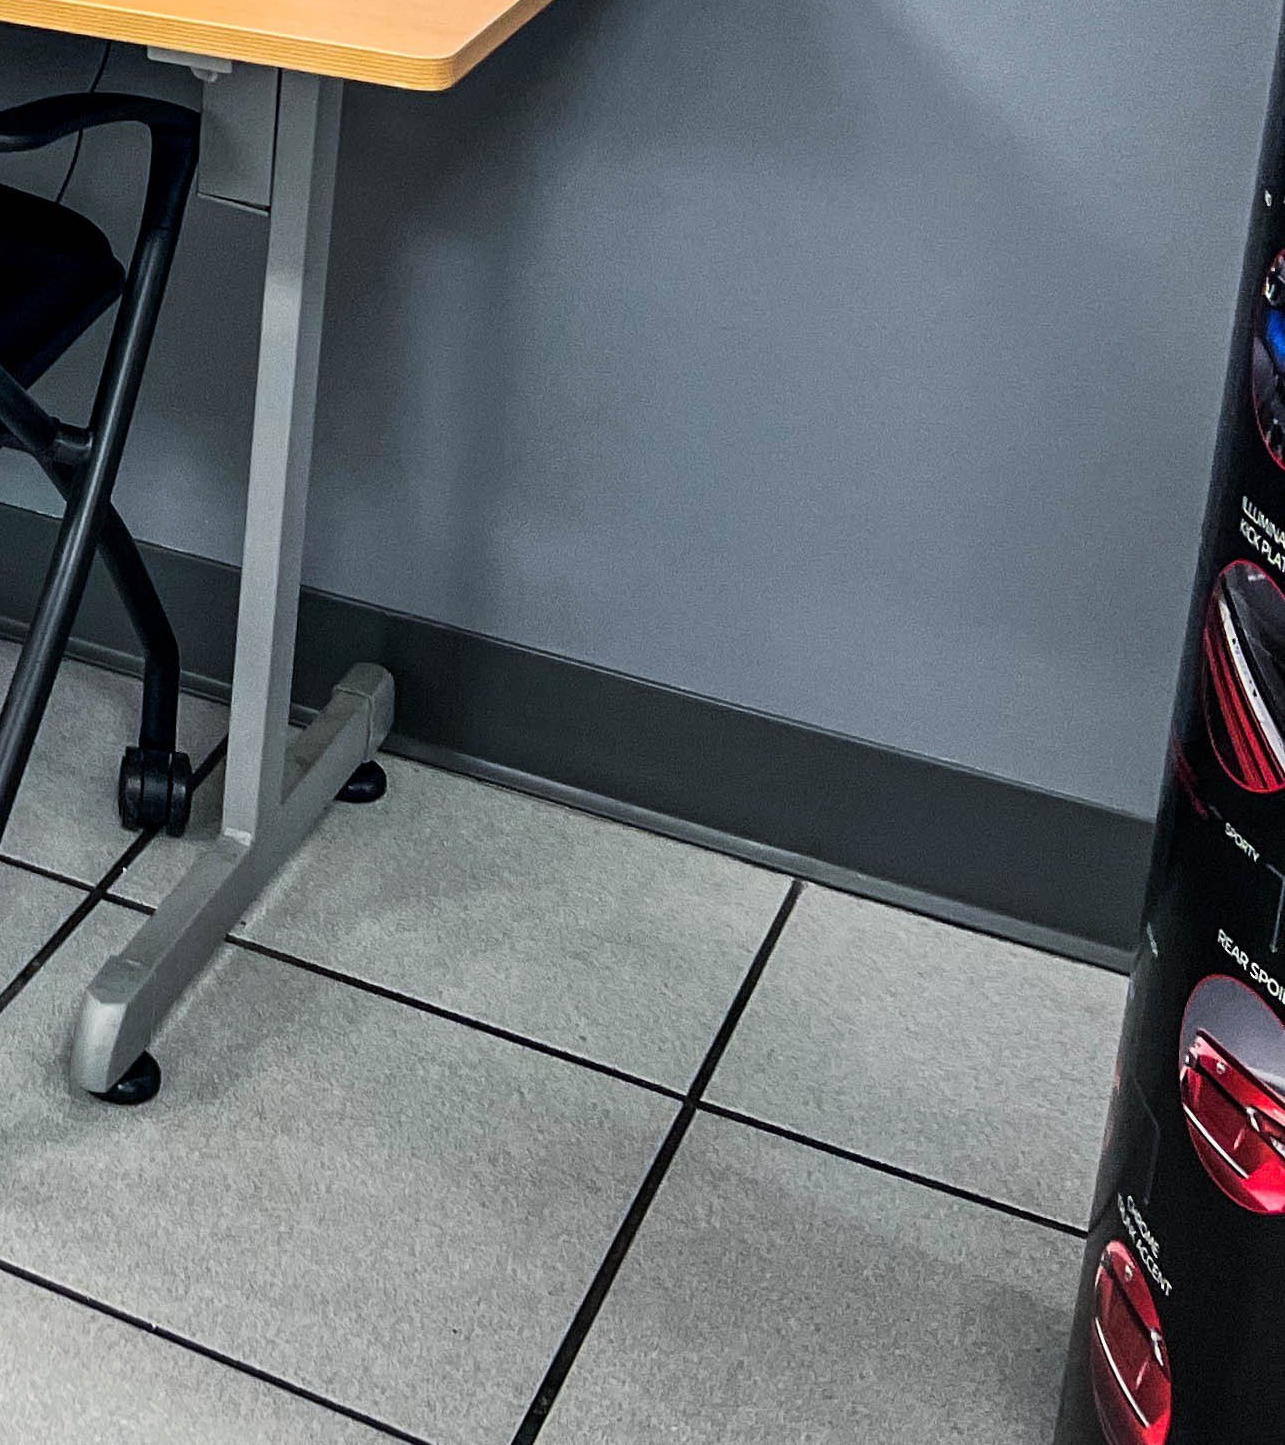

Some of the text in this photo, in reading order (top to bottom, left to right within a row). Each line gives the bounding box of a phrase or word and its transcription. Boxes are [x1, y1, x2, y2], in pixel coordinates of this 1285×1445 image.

[1225, 822, 1260, 863] SPORTY
[1217, 928, 1249, 971] REAR
[1136, 1238, 1173, 1296] ACCENT
